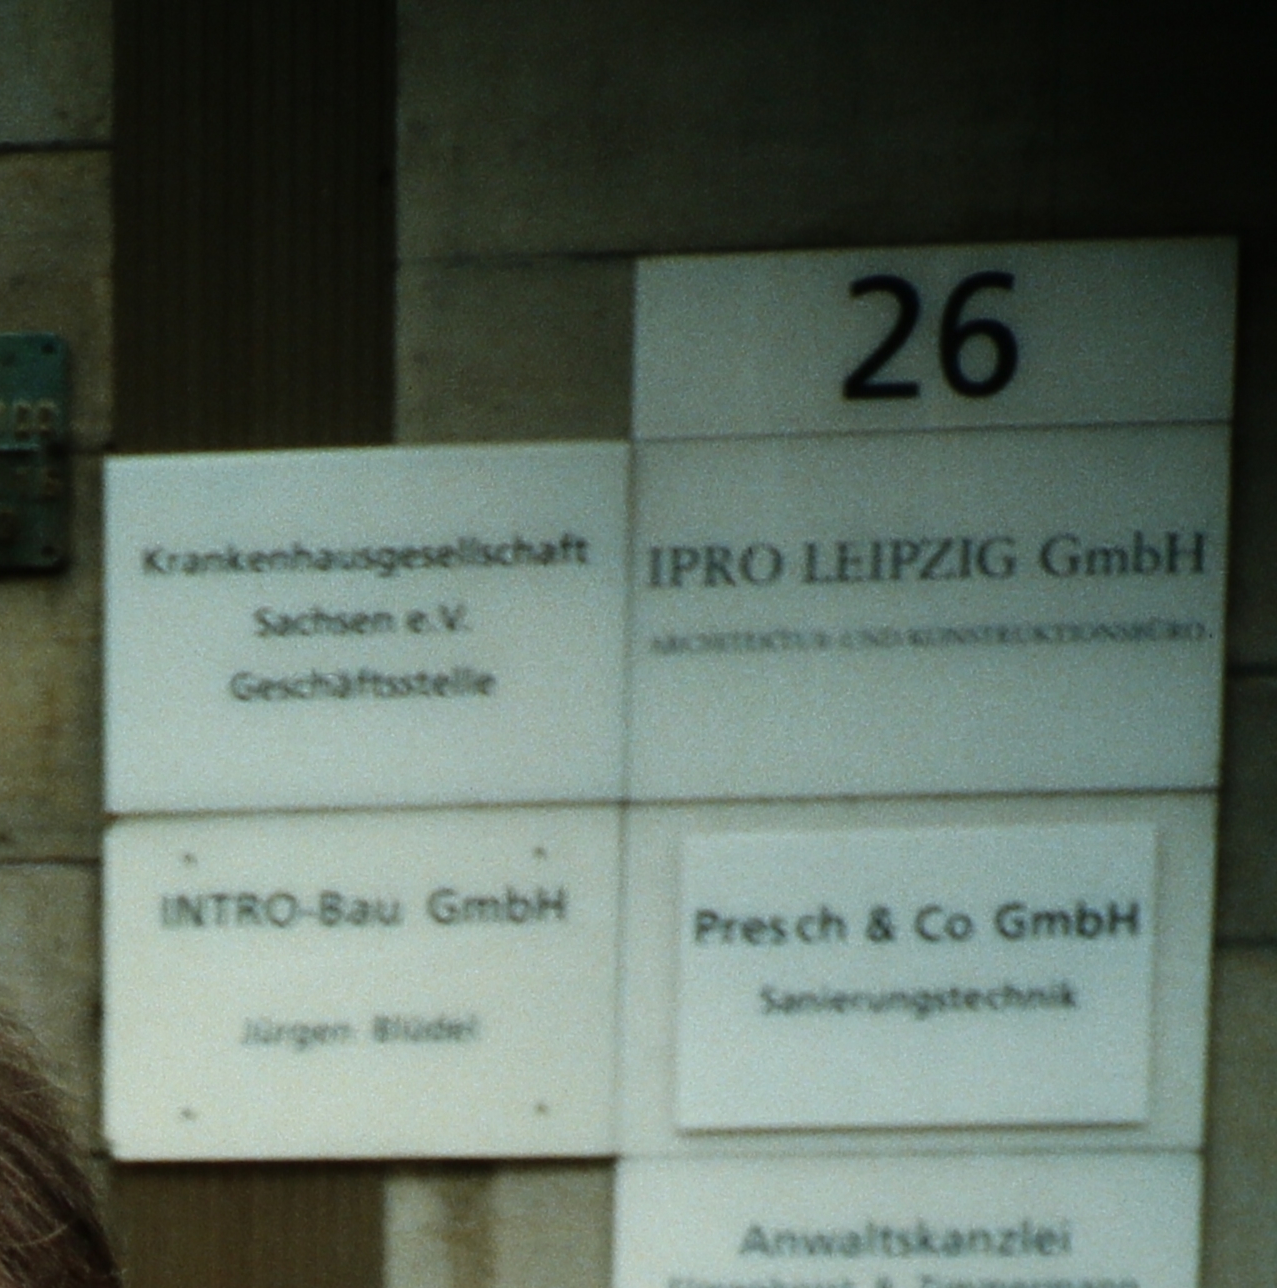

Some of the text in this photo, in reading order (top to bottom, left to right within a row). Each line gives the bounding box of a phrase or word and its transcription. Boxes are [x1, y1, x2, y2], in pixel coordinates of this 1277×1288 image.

[842, 271, 1019, 401] 26
[142, 532, 591, 577] Krankenhausgesellschaft
[646, 530, 1207, 590] IPRO LEIPZIG GmbH
[253, 605, 396, 638] Sachsen
[229, 667, 497, 700] Geschäftsstelle
[160, 885, 569, 929] INTRO-Bau GmbH
[693, 899, 1141, 944] Presch & Co GmbH
[759, 979, 1079, 1020] Sanierungstechnik
[738, 1216, 1073, 1258] Anwaltskanzlei
